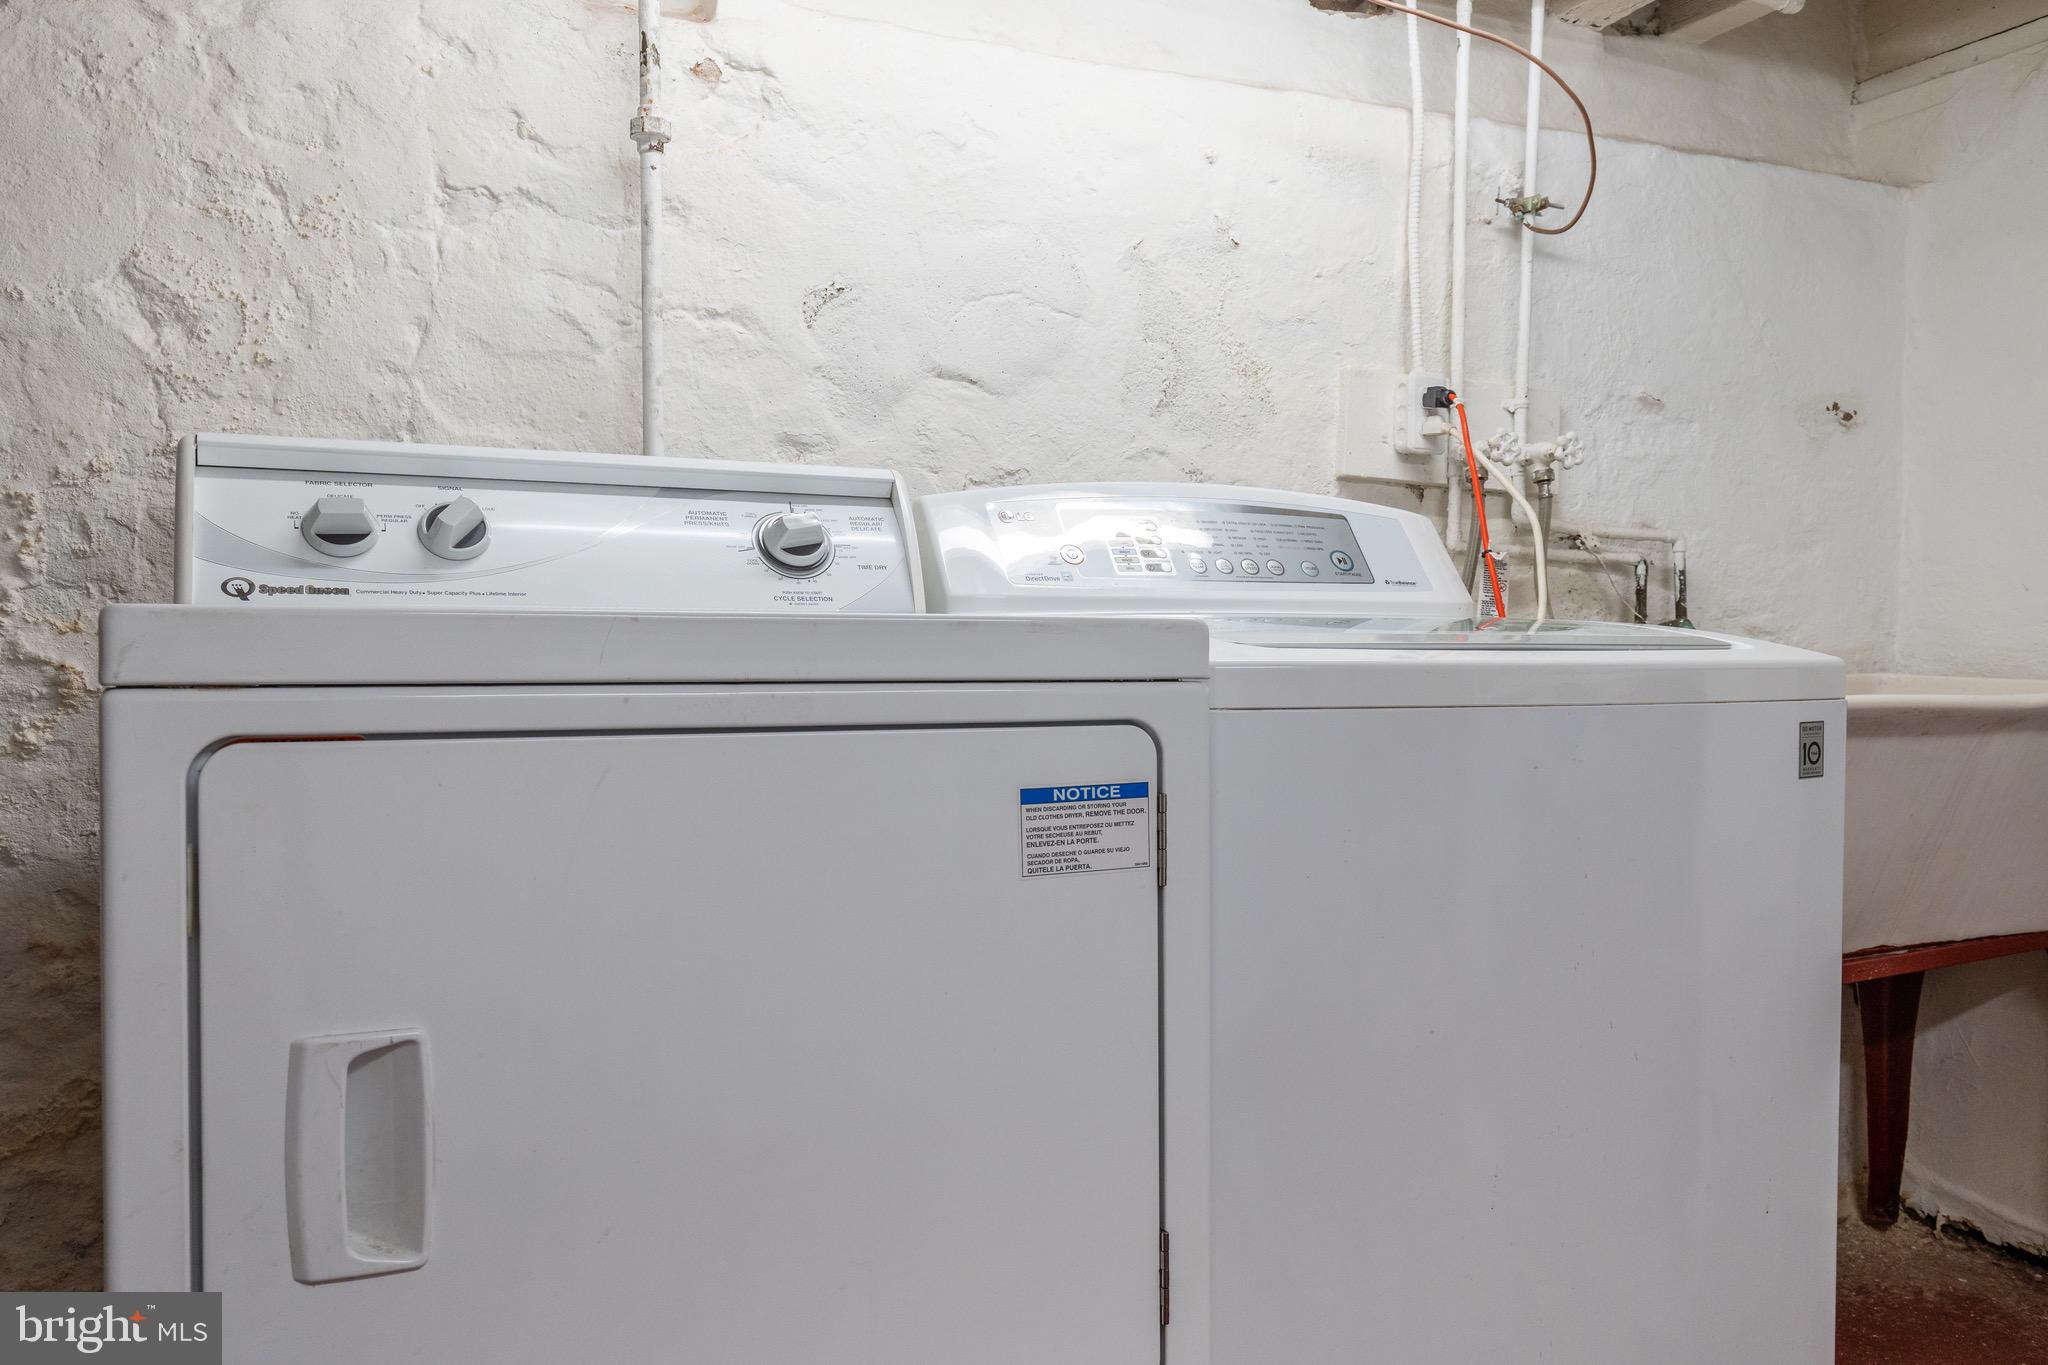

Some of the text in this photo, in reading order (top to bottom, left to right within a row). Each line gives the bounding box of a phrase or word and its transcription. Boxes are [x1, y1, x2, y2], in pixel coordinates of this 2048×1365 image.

[258, 584, 350, 596] Speed Queen
[1803, 742, 1821, 766] 10
[1053, 785, 1121, 801] NOTICE
[1027, 866, 1054, 874] QUITELE
